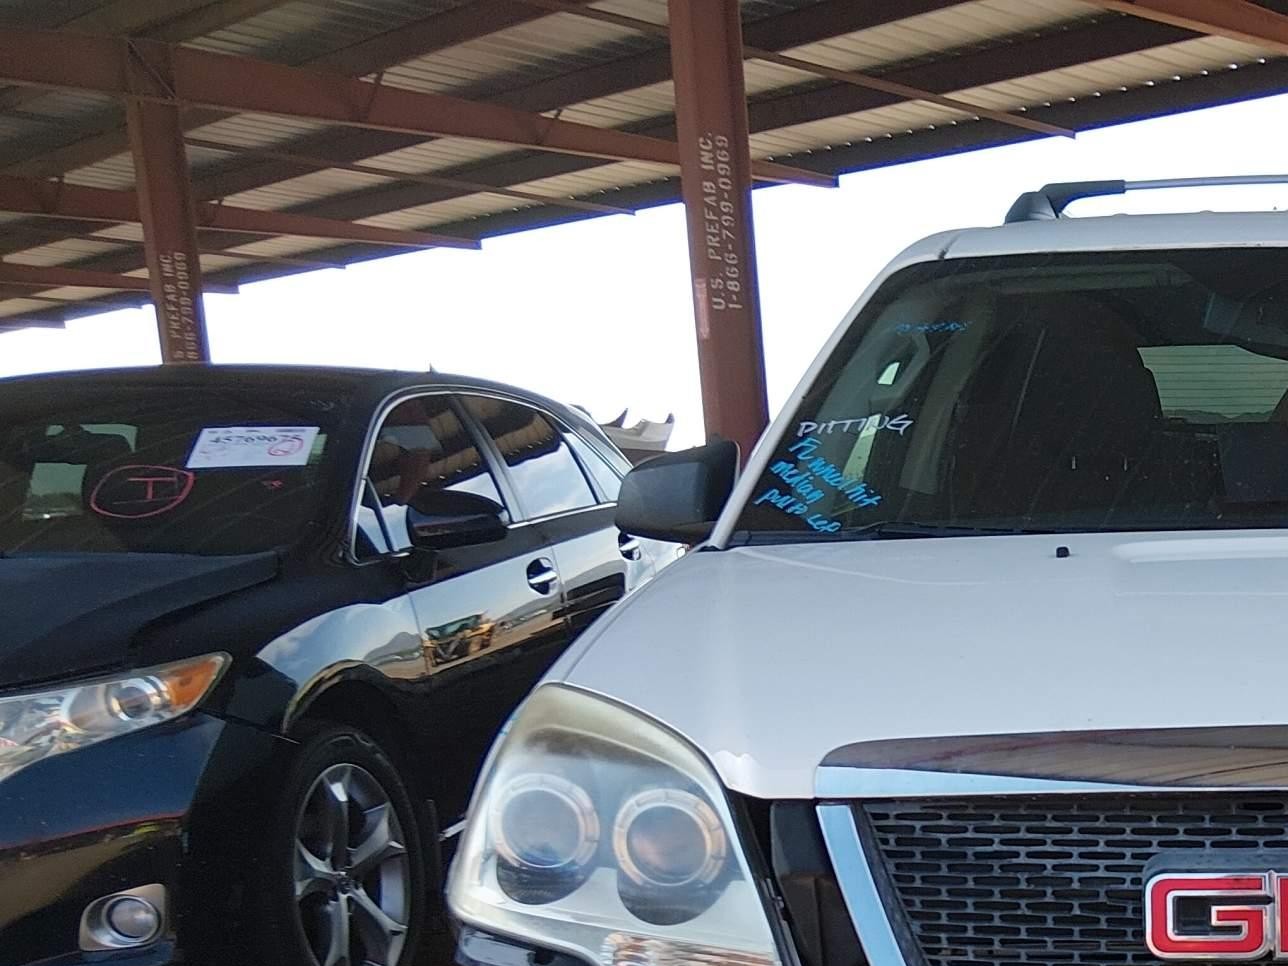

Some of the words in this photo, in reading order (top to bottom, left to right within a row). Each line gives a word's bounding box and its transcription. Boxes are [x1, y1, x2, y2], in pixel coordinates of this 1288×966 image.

[699, 132, 715, 170] INC.
[702, 181, 722, 261] PREFAB
[715, 135, 743, 310] 1-866-799-0969
[710, 272, 726, 310] U.S.
